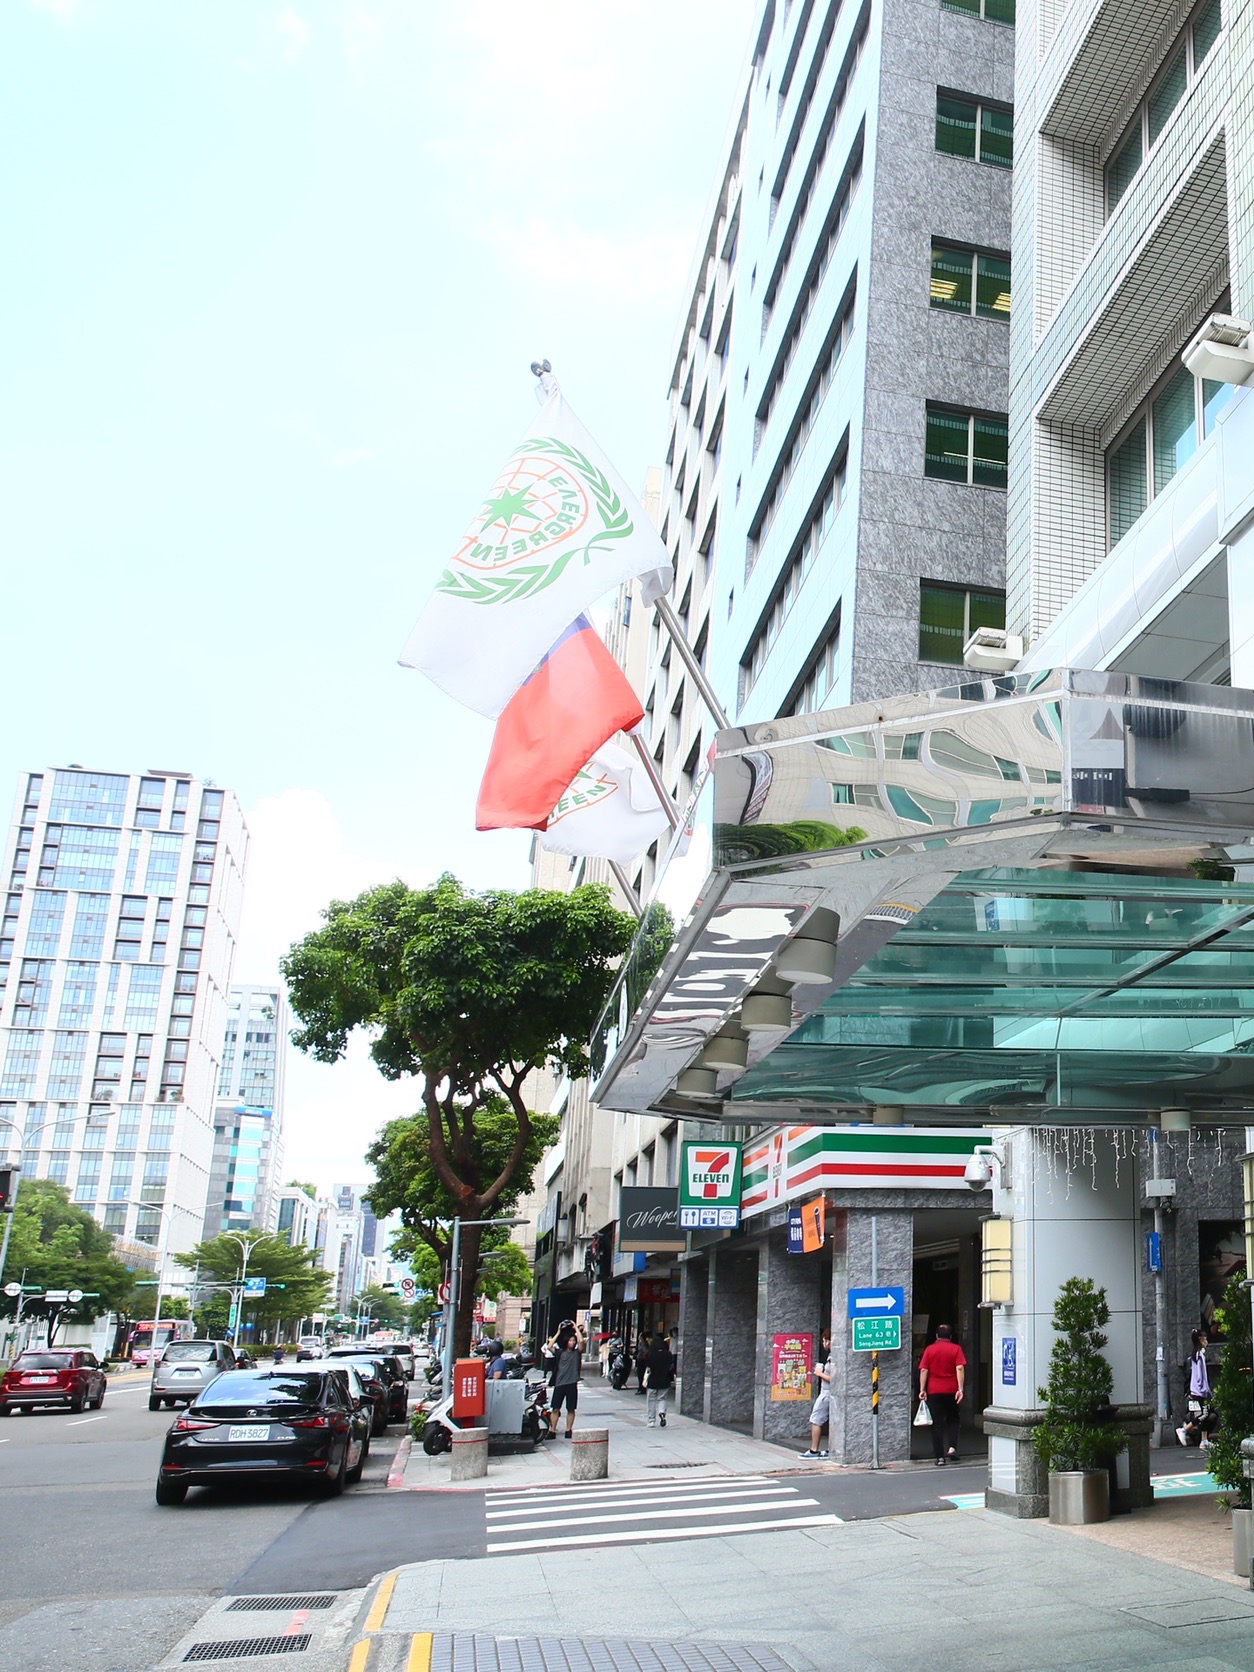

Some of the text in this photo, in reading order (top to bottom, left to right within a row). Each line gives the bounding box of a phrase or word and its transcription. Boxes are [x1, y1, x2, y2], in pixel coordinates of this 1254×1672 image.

[695, 1151, 730, 1198] 7
[857, 1320, 893, 1330] 松江路
